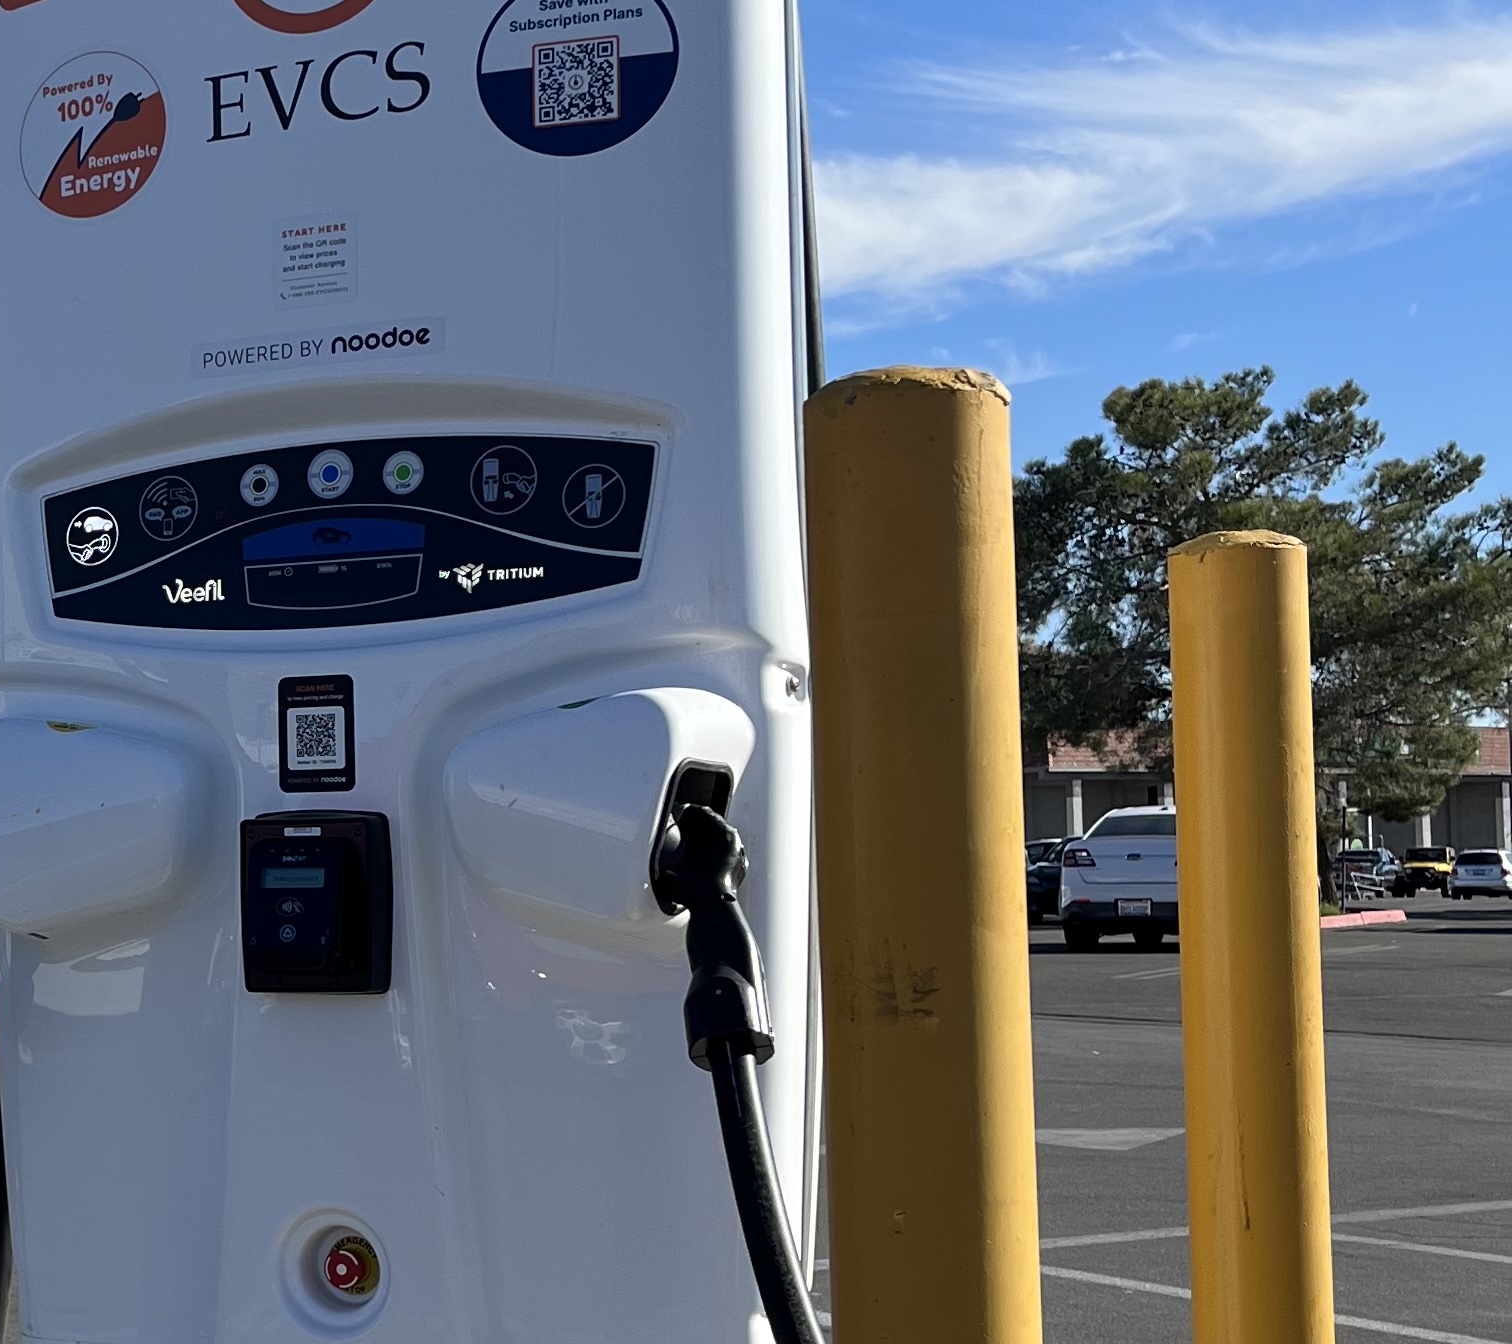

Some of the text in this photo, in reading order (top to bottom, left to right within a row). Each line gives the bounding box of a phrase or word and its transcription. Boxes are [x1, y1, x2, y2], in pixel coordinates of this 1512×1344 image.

[509, 7, 644, 33] Subscription Plans
[42, 72, 114, 99] Powered By
[203, 40, 431, 143] EVCS
[56, 90, 114, 123] 100%
[87, 143, 159, 169] Renewable
[60, 165, 141, 198] Energy
[281, 222, 347, 239] START HERE
[283, 243, 301, 252] Scan
[329, 237, 347, 246] code
[316, 249, 338, 260] prices
[282, 259, 346, 273] and start charging
[202, 326, 432, 369] POWERED BY noodoe
[320, 485, 340, 494] START
[394, 482, 412, 491] STOP
[161, 566, 544, 605] Veefil by TRITIUM
[334, 1236, 377, 1259] MERGENCY
